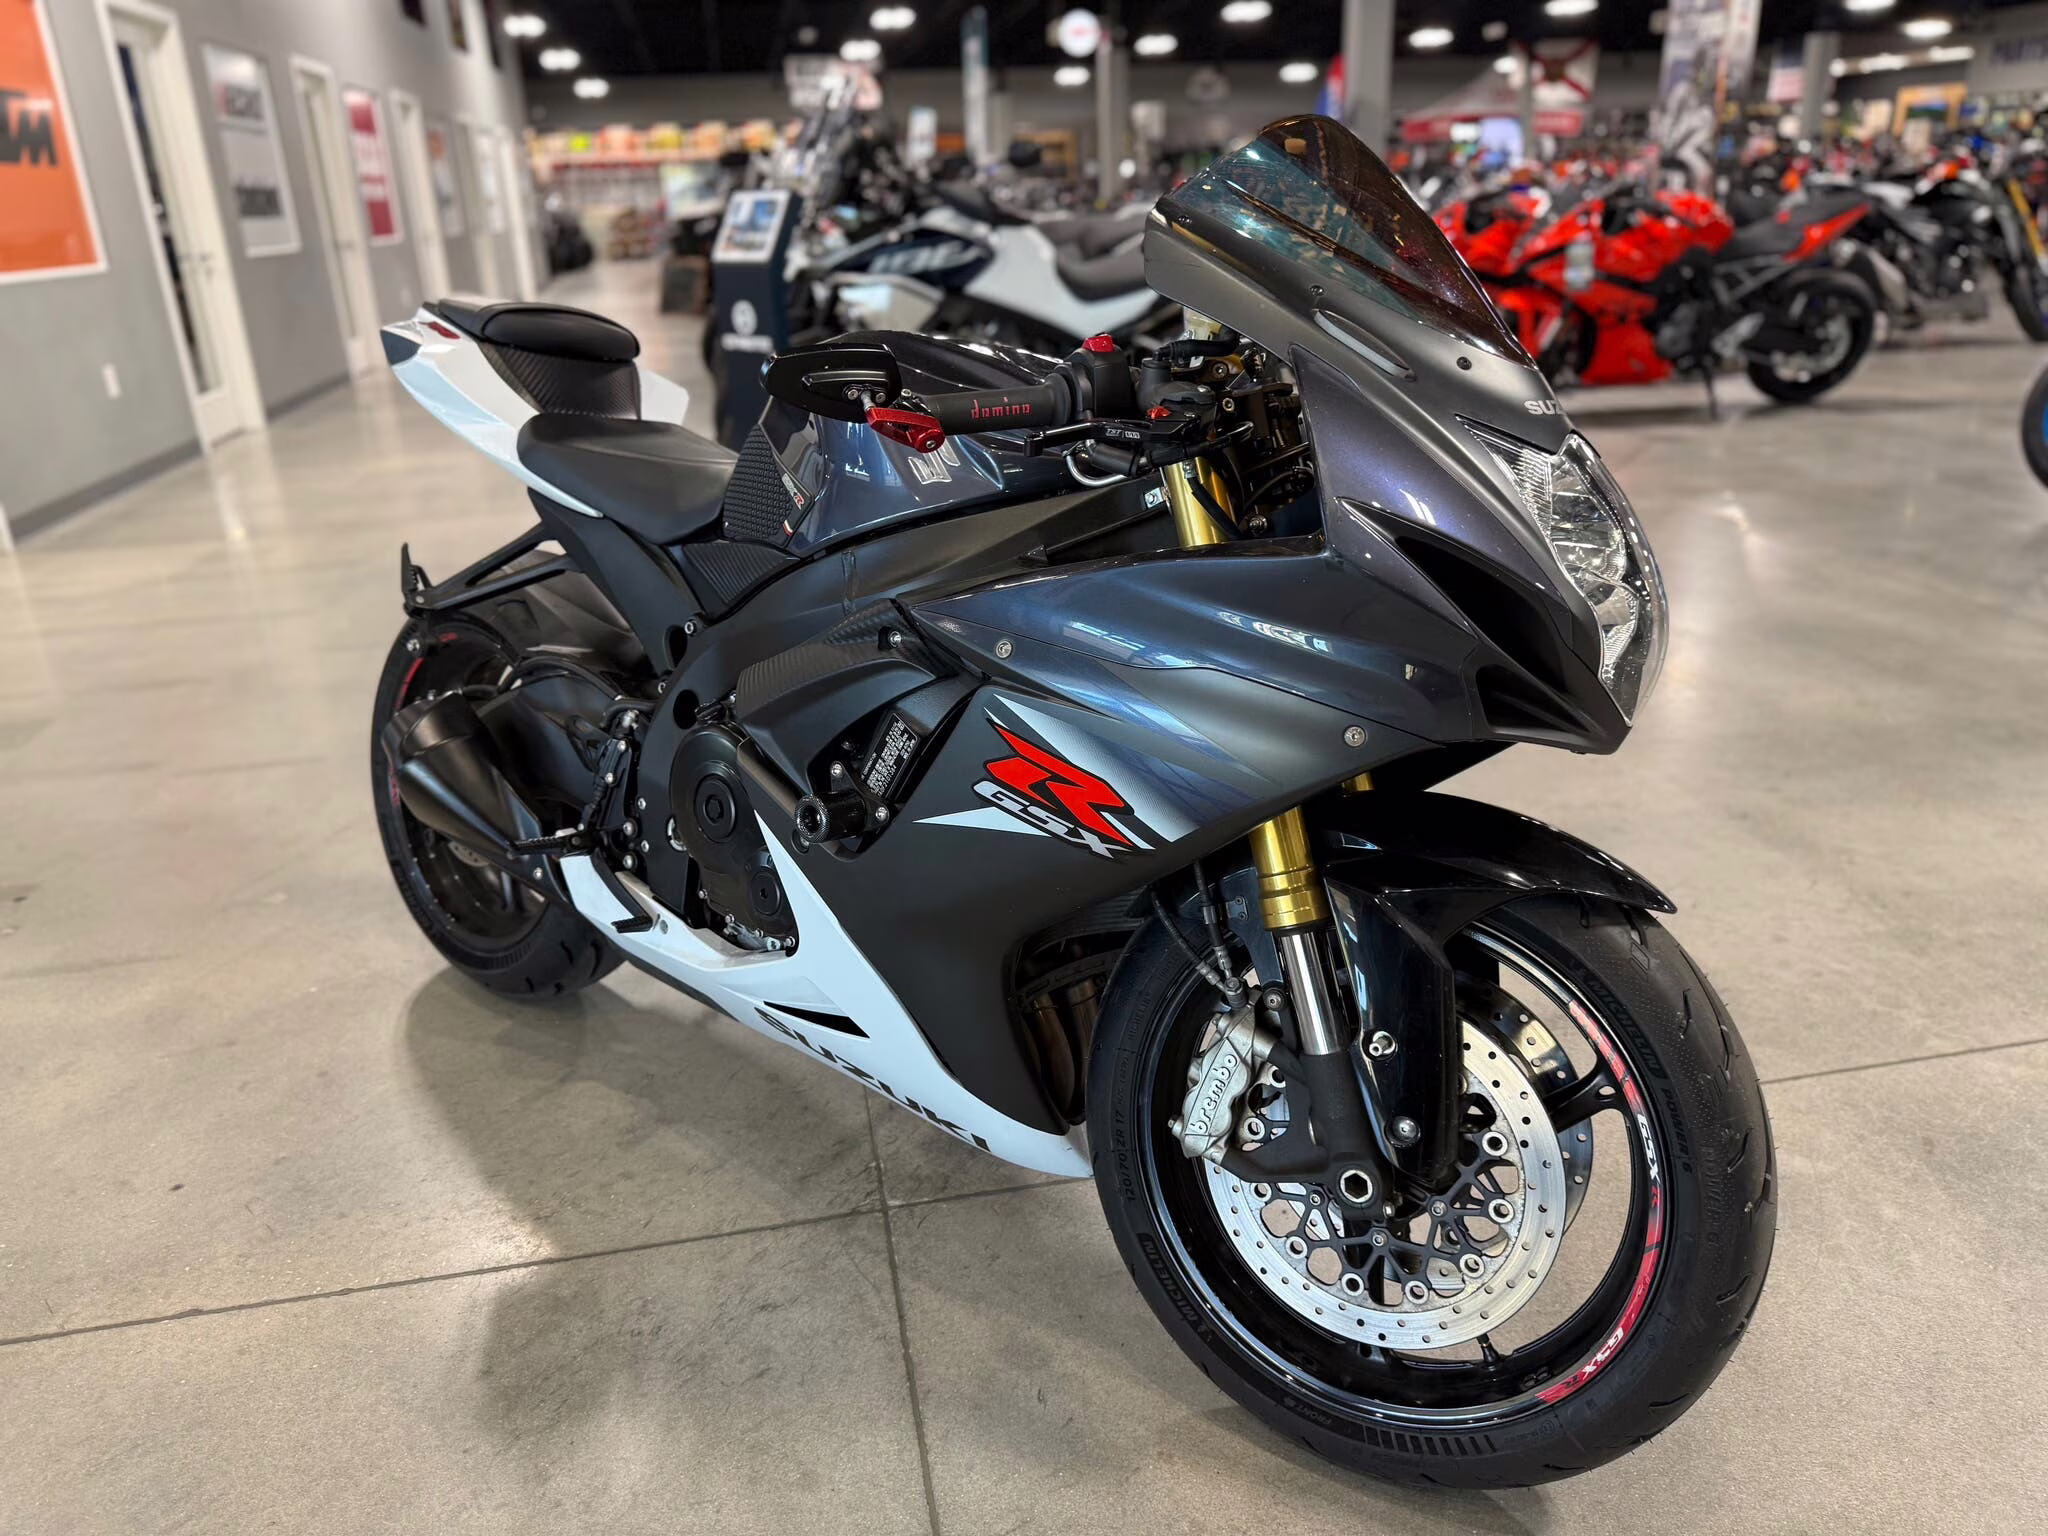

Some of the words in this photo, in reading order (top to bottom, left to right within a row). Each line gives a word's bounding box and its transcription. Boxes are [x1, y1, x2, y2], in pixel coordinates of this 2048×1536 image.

[971, 397, 1031, 419] domino
[973, 780, 1133, 859] GSX
[1588, 981, 1661, 1070] MICHELIN
[754, 1007, 991, 1153] SUZUKI
[1190, 1054, 1238, 1134] brembo
[1637, 1113, 1661, 1183] GSX
[1141, 1241, 1199, 1320] MICHELIN
[1581, 1326, 1623, 1380] GSX
